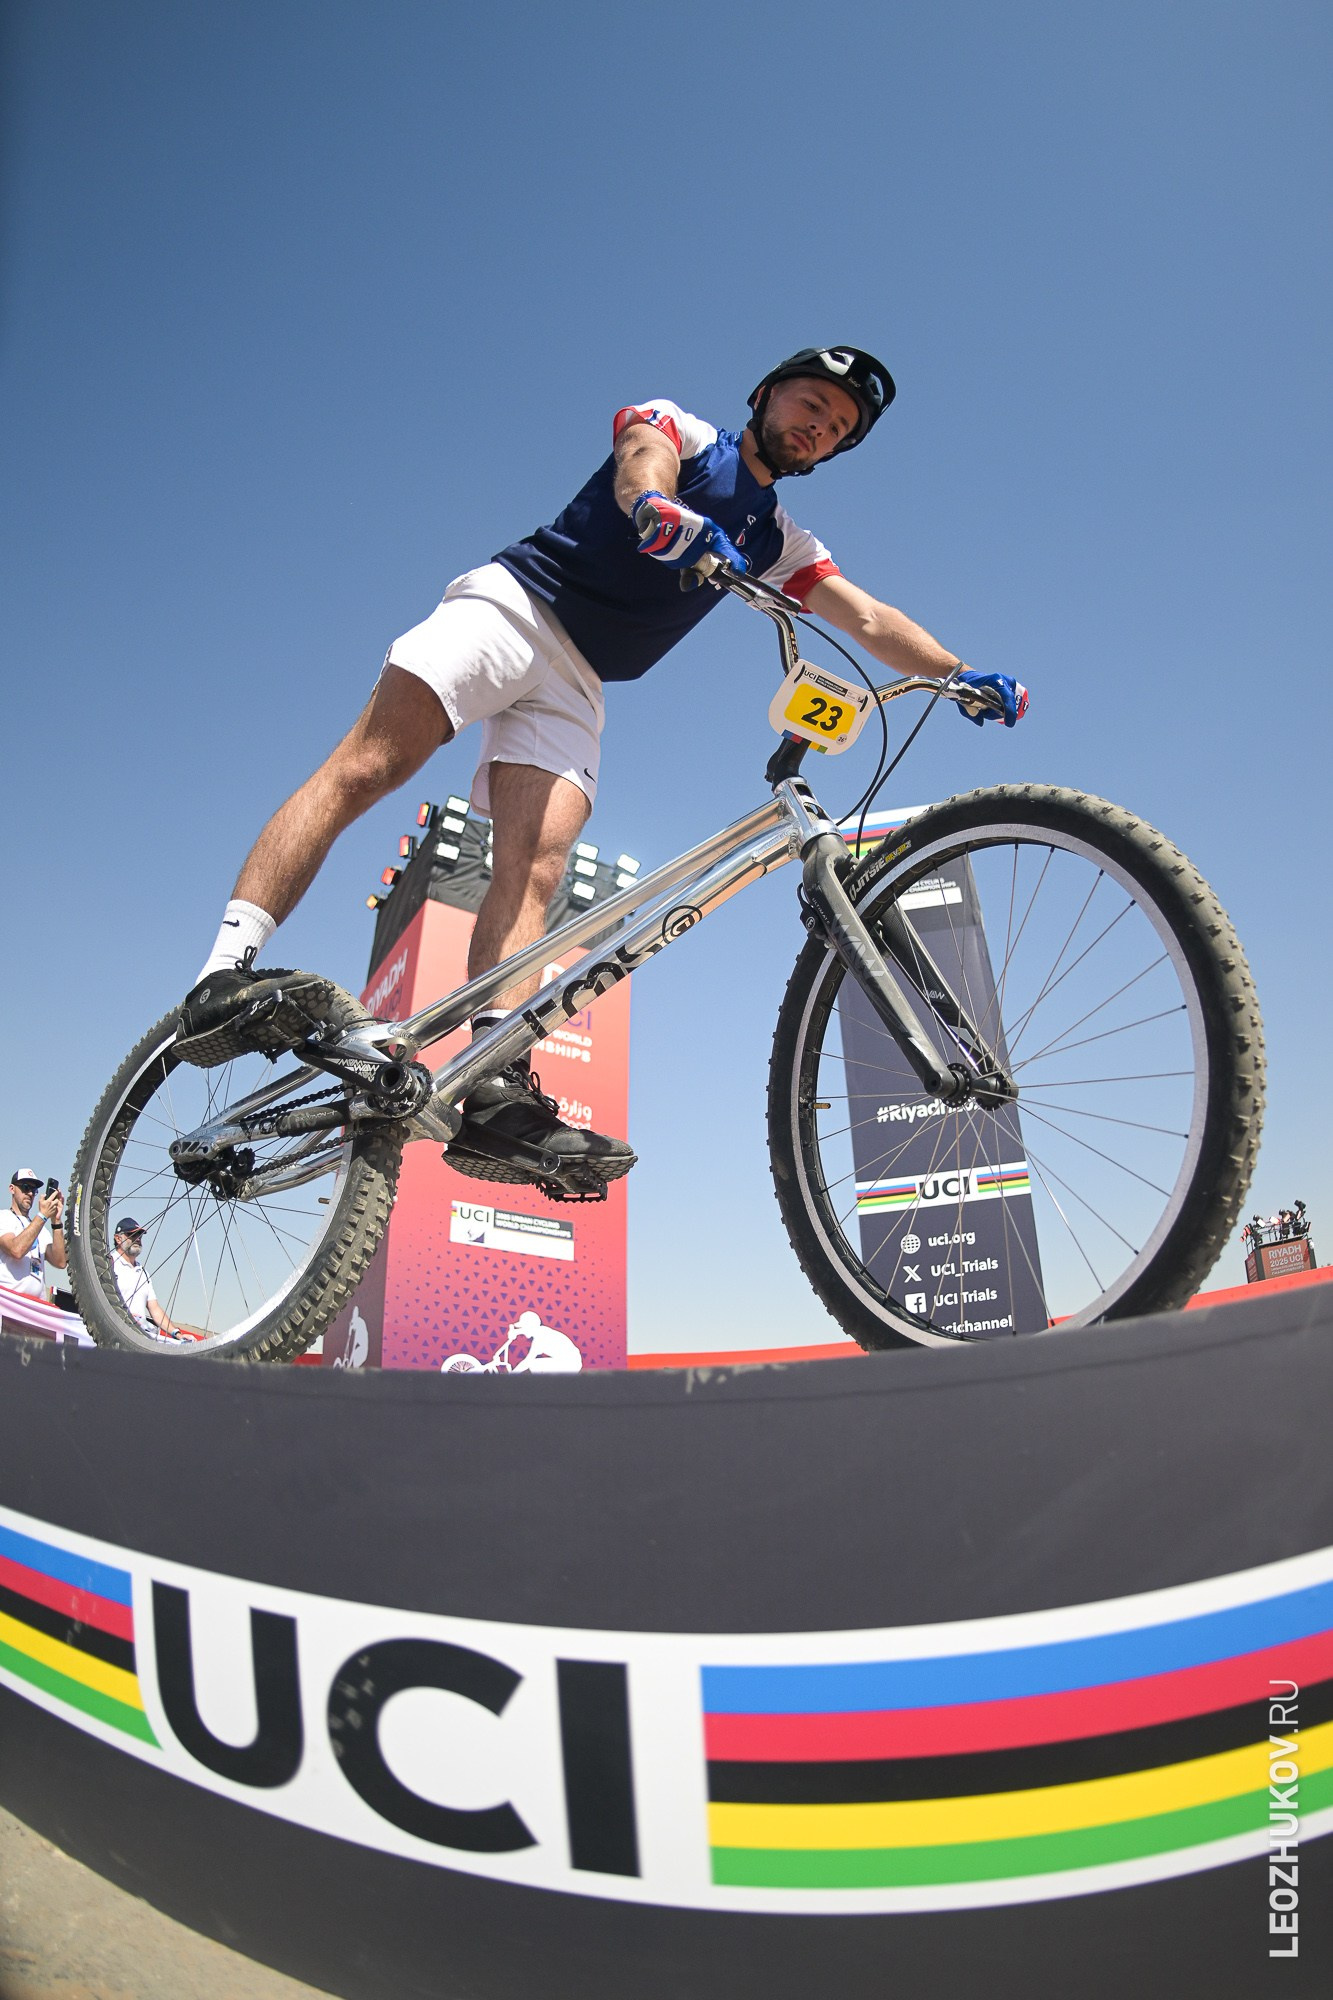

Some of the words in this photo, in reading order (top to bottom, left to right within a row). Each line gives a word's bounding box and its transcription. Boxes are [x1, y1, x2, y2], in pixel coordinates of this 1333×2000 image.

[803, 671, 817, 681] UCI
[801, 697, 843, 732] 23
[919, 1176, 971, 1200] UCI
[460, 1207, 489, 1223] UCI
[928, 1231, 976, 1247] uci.org
[1268, 1245, 1302, 1259] RIYADH
[1289, 1254, 1304, 1265] UCI
[930, 1257, 999, 1277] UCI_Trials
[934, 1292, 959, 1307] UCI
[960, 1288, 998, 1304] Trials
[151, 1578, 642, 1879] UCI
